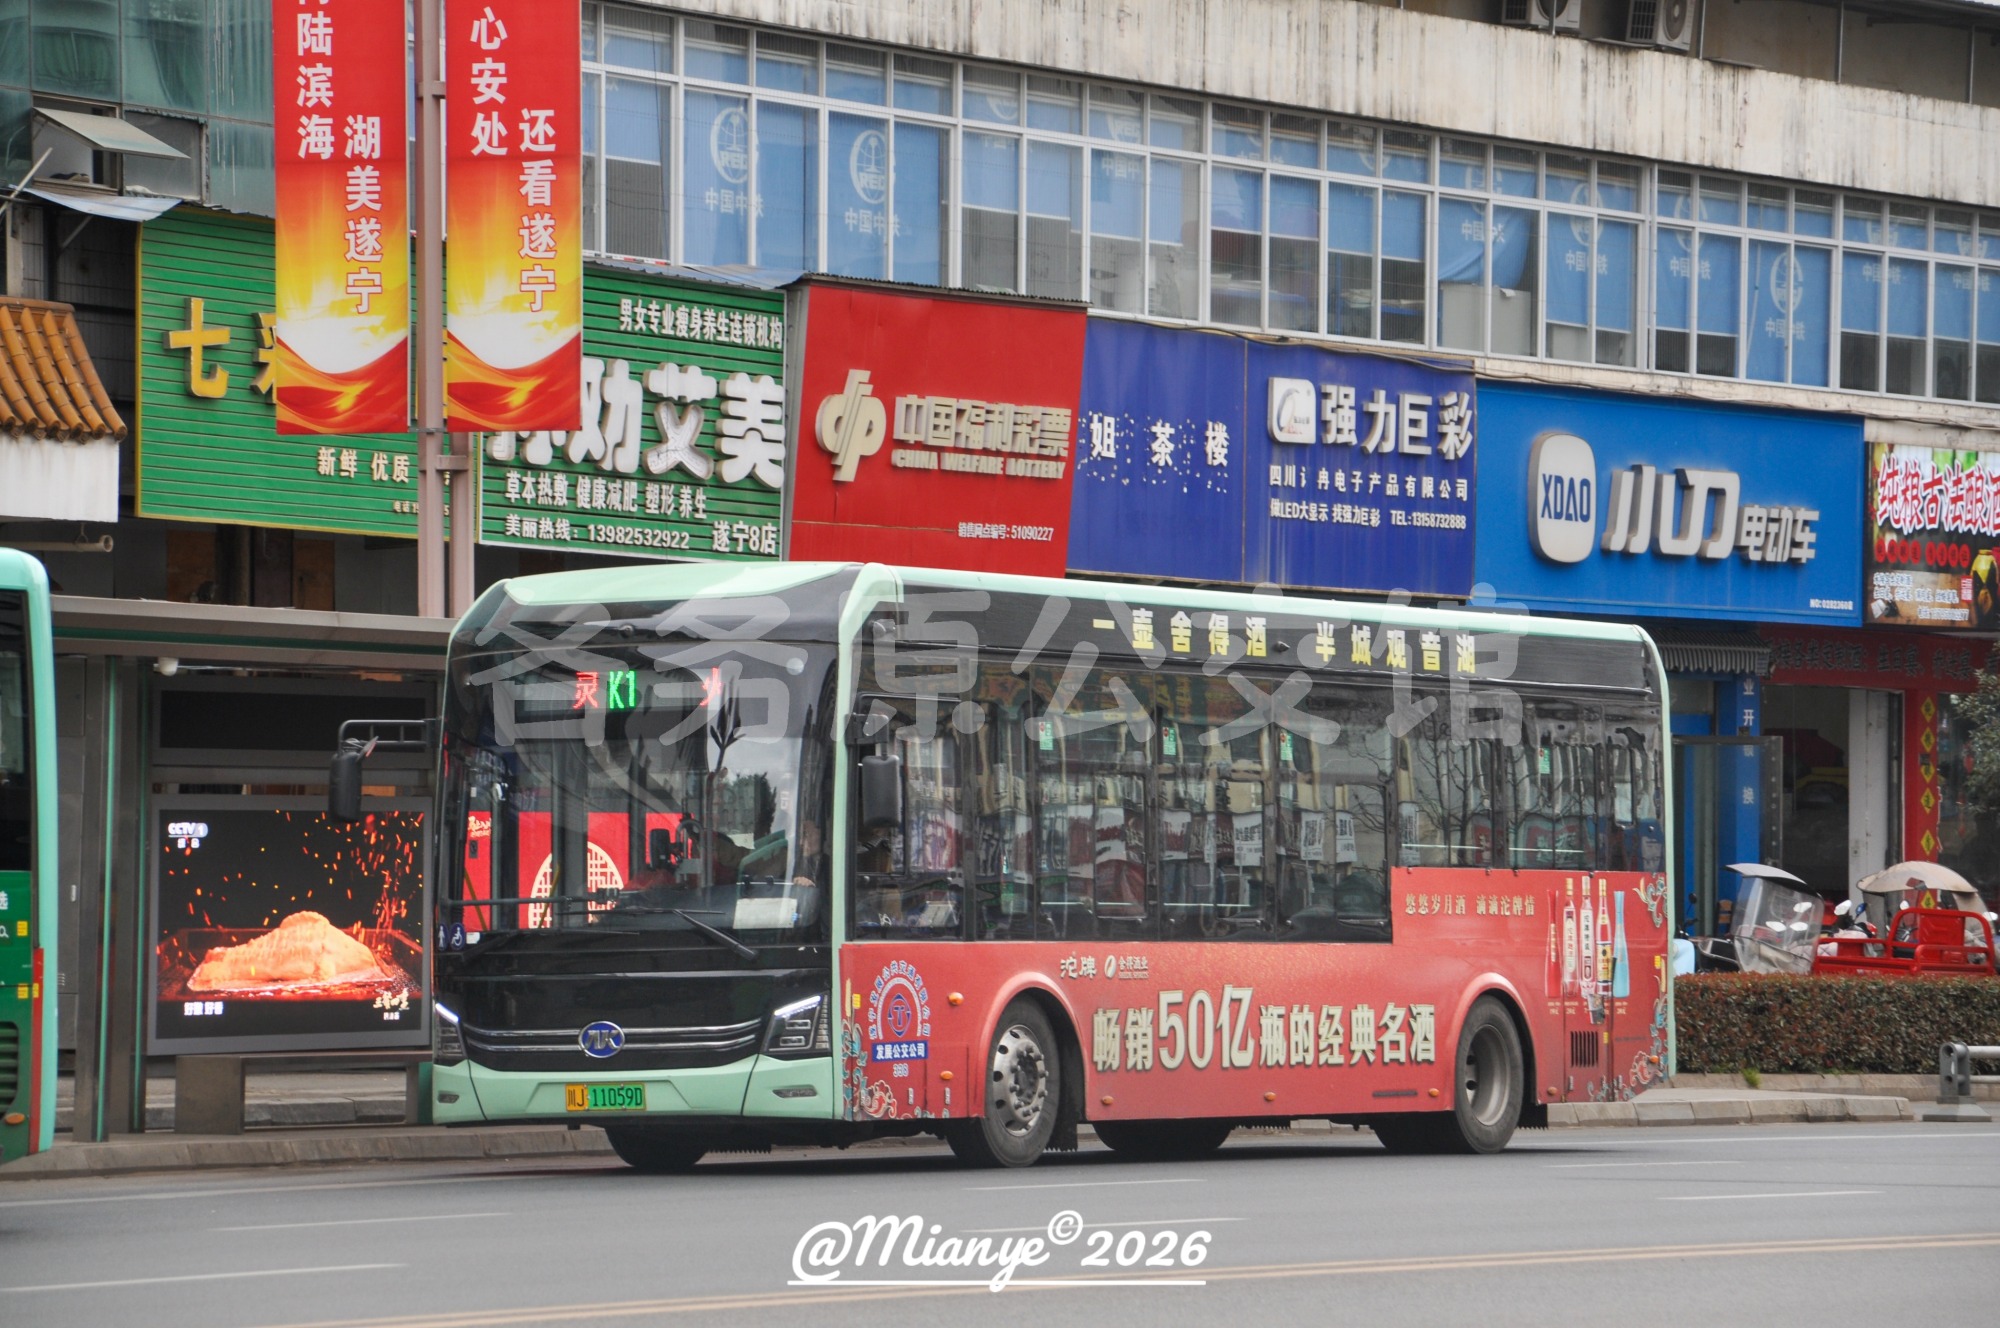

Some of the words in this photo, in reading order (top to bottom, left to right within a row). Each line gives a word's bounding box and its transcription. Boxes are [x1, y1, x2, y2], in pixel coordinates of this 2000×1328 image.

[297, 0, 334, 160] 陆滨海
[470, 8, 508, 156] 心安处
[344, 115, 383, 314] 湖美遂宁
[519, 109, 557, 312] 还看遂宁
[619, 297, 783, 349] 男女专业瘦身养生连锁机构
[893, 394, 1072, 457] 中国福利彩票
[1320, 384, 1474, 460] 强力巨彩
[317, 446, 357, 478] 新鲜
[371, 452, 410, 483] 优质
[891, 449, 938, 470] CHINA
[941, 452, 1004, 475] WELFARE
[1006, 457, 1066, 479] LOTTERY
[505, 470, 569, 507] 草本热敷
[576, 474, 638, 513] 健康减肥
[645, 482, 675, 515] 塑形
[679, 484, 707, 519] 养生
[1541, 473, 1591, 523] XDAO
[587, 523, 690, 550] 13982532922
[711, 520, 778, 554] 遂宁8店
[1738, 504, 1819, 563] 电动车
[1093, 608, 1267, 658] 一壶舍得酒
[1315, 620, 1476, 674] 半城观音湖
[609, 670, 636, 709] K1
[1405, 893, 1467, 915] 悠悠岁月酒
[875, 1043, 926, 1060] 发展公交公司
[1093, 984, 1437, 1073] 畅销50亿瓶的经典名酒
